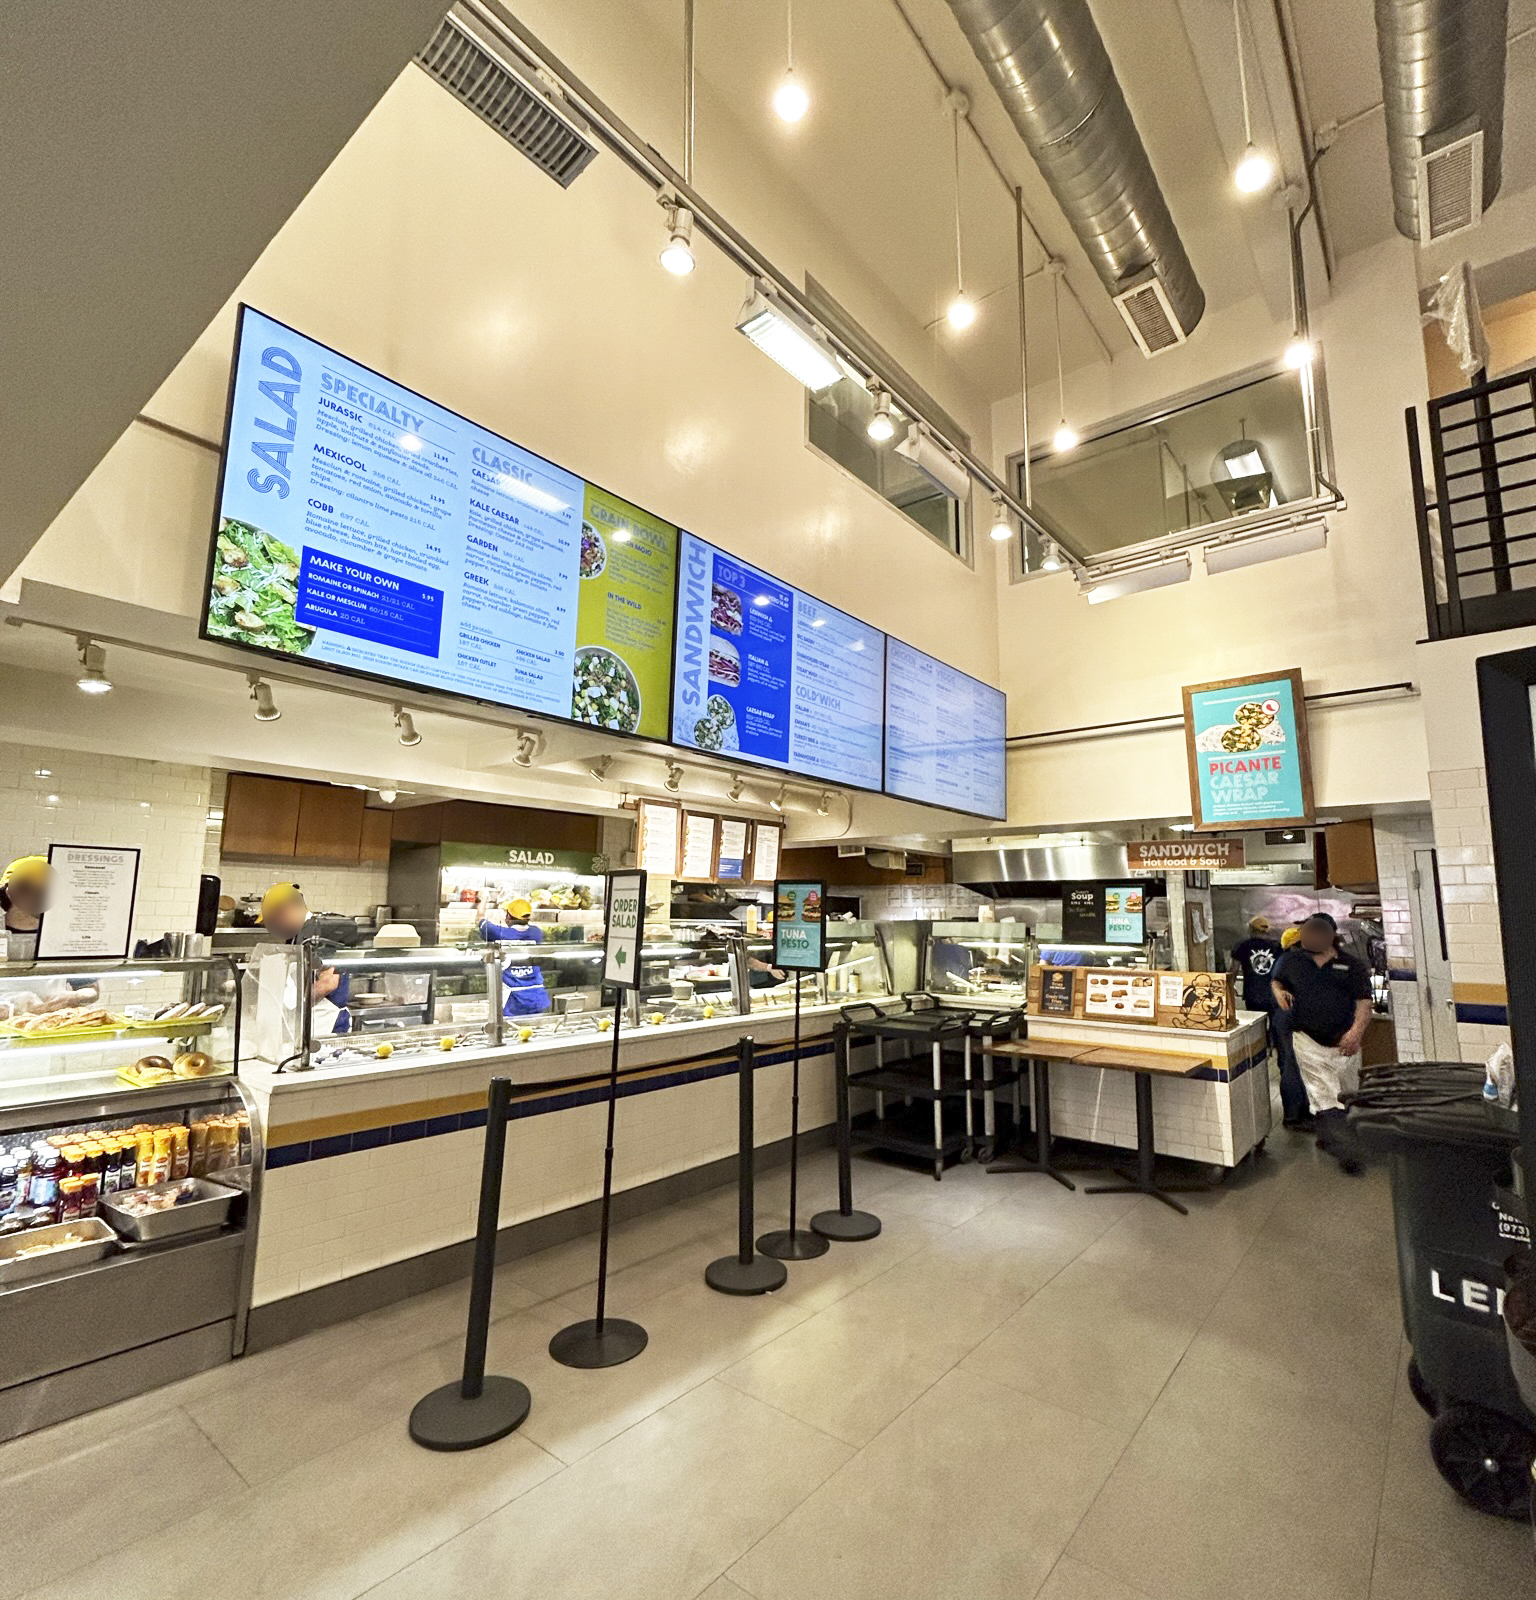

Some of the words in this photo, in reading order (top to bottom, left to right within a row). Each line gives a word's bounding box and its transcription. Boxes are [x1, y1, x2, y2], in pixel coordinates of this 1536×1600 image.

[318, 396, 362, 423] JURASSIC
[320, 370, 424, 435] SPECIALTY
[247, 346, 302, 500] SALAD
[350, 423, 373, 439] grilled
[316, 415, 339, 431] apple,
[340, 426, 369, 444] walnuts
[377, 443, 410, 462] sunflower
[313, 442, 367, 472] MEXICOOL
[315, 422, 350, 443] Dressing:
[351, 438, 372, 453] lemon
[408, 464, 423, 475] olive
[471, 444, 532, 486] CLASSIC
[310, 469, 332, 484] chips.
[310, 477, 344, 496] Dressing:
[345, 491, 373, 508] cilantro
[374, 502, 389, 514] lime
[390, 508, 408, 521] pesto
[311, 462, 347, 482] tomatoes,
[349, 477, 361, 488] red
[362, 483, 383, 496] onion,
[384, 492, 412, 508] avocado
[420, 506, 442, 520] tortilla
[351, 471, 382, 489] romaine,
[383, 484, 405, 498] grilled
[406, 494, 432, 509] chicken,
[433, 505, 451, 517] grape
[307, 497, 334, 514] COBB
[354, 514, 369, 527] CAL
[469, 497, 490, 513] KALE
[491, 507, 519, 525] CAESAR
[304, 524, 338, 542] avocado,
[339, 536, 375, 555] cucumber
[383, 552, 403, 564] grape
[404, 559, 427, 572] tomato
[305, 517, 321, 529] blue
[323, 523, 349, 539] cheese,
[351, 533, 372, 547] bacon
[374, 541, 389, 552] bits,
[390, 547, 406, 558] hard
[407, 553, 427, 565] boiled
[306, 510, 338, 527] Romaine
[340, 522, 366, 537] lettuce,
[367, 532, 390, 546] grilled
[391, 540, 418, 556] chicken,
[419, 550, 448, 567] crumbled
[466, 533, 497, 552] GARDEN
[309, 555, 342, 573] MAKE
[344, 566, 371, 582] YOUR
[373, 575, 399, 591] OWN
[463, 570, 489, 586] GREEK
[717, 563, 738, 585] TOP
[308, 572, 341, 587] ROMAINE
[352, 586, 379, 599] SPINACH
[306, 587, 324, 598] KALE
[336, 596, 366, 610] MESCLUN
[389, 611, 403, 620] CAL
[461, 600, 480, 611] cheese
[615, 594, 624, 603] THE
[305, 602, 337, 617] ARUGULA
[350, 615, 365, 624] CAL
[512, 605, 527, 615] green
[681, 539, 705, 707] SANDWICH
[459, 632, 479, 642] GRILLED
[480, 638, 500, 648] CHICKEN
[457, 652, 478, 662] CHICKEN
[479, 658, 496, 667] CUTLET
[516, 648, 535, 658] CHICKEN
[1210, 756, 1281, 775] PICANTE
[1210, 771, 1278, 789] CAESAR
[1211, 786, 1268, 803] WRAP
[67, 853, 124, 863] DRESSINGS
[509, 850, 554, 865] SALAD
[1140, 843, 1229, 857] SANDWICH
[1143, 858, 1161, 867] Hot
[1163, 857, 1187, 866] food
[1189, 857, 1197, 866] &
[1199, 857, 1227, 866] Soup
[613, 899, 637, 912] ORDER
[1071, 892, 1094, 901] Soup
[612, 914, 636, 928] SALAD
[781, 929, 807, 939] TUNA
[781, 939, 809, 949] PESTO
[1499, 1222, 1530, 1238] (973)
